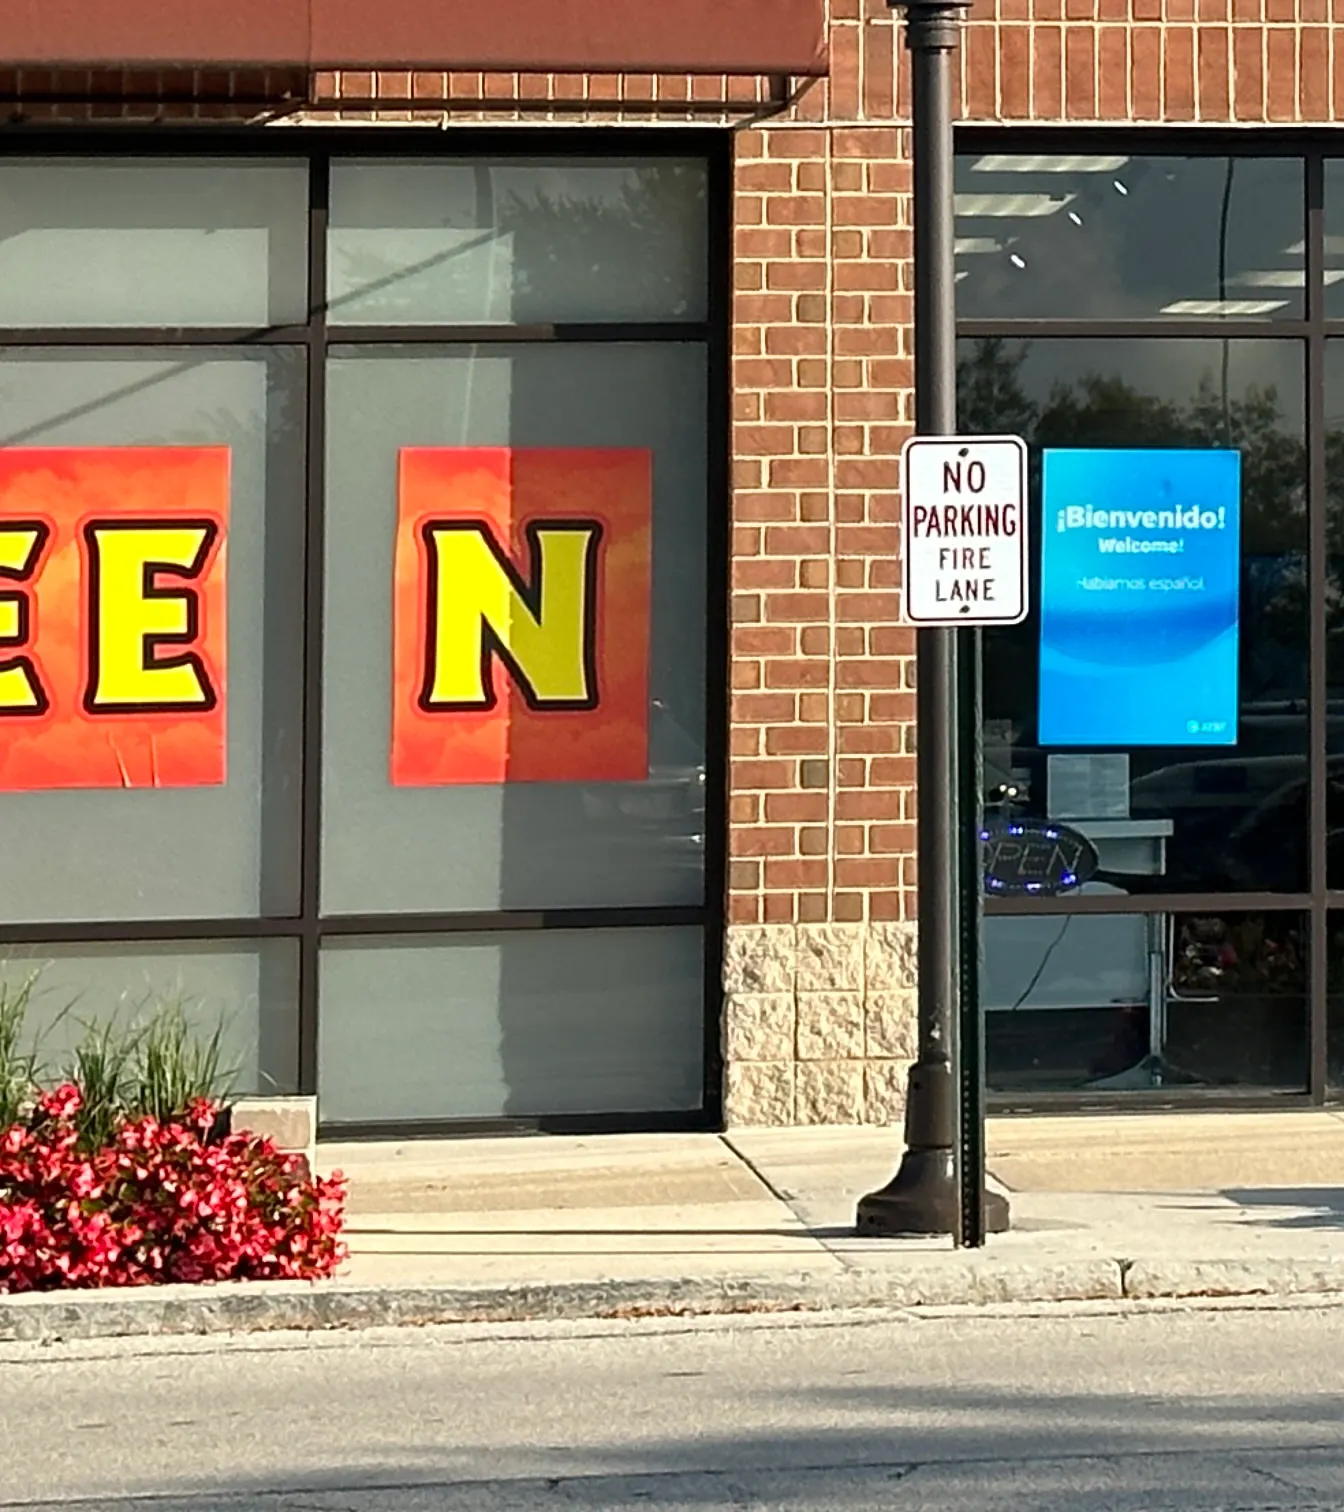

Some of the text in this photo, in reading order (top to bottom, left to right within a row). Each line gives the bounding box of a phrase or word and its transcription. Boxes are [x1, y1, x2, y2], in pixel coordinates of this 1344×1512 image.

[942, 460, 986, 494] NO
[913, 503, 1017, 538] PARKING
[1057, 504, 1226, 533] ¡Bienvenido!
[1098, 536, 1184, 554] Welcome!
[939, 547, 992, 571] FIRE
[935, 579, 996, 603] LANE
